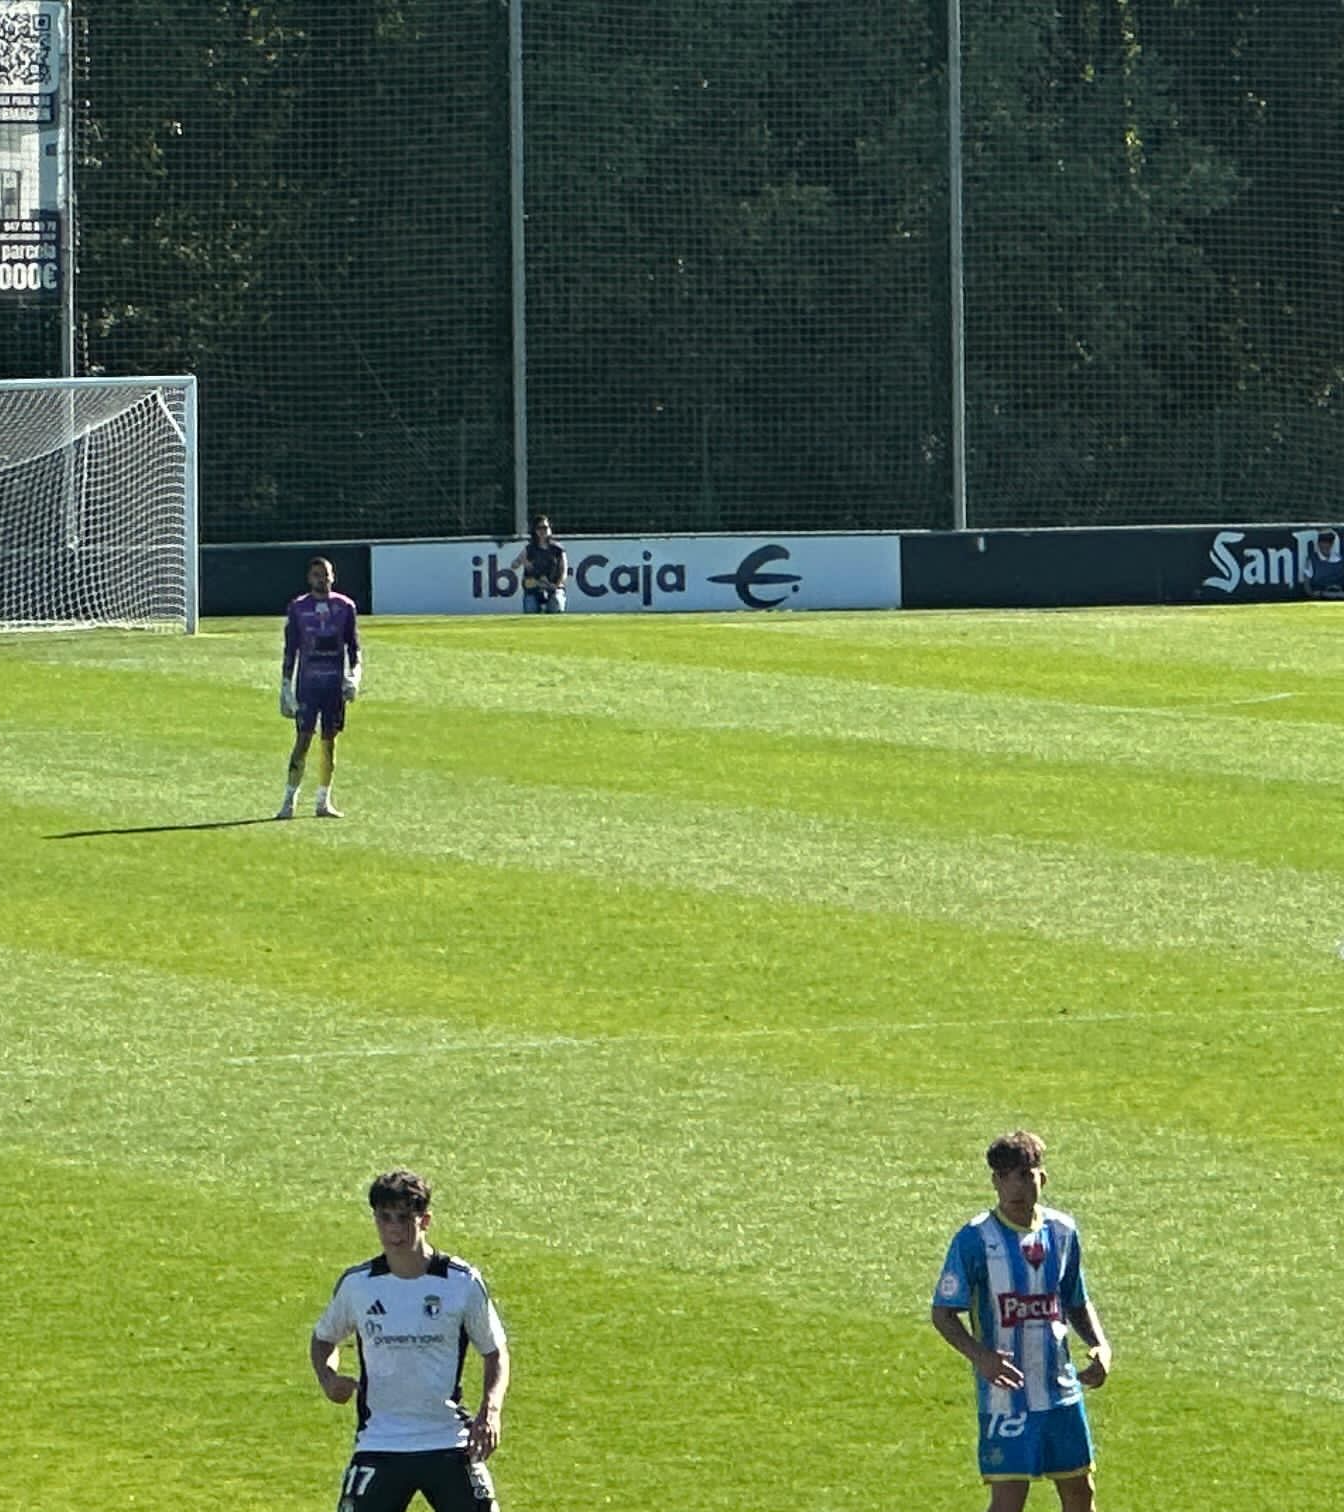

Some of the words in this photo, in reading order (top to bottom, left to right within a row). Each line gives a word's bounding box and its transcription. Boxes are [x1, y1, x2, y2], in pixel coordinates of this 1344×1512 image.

[472, 551, 686, 606] ibCaja
[1205, 531, 1293, 591] San
[344, 1464, 377, 1496] 17
